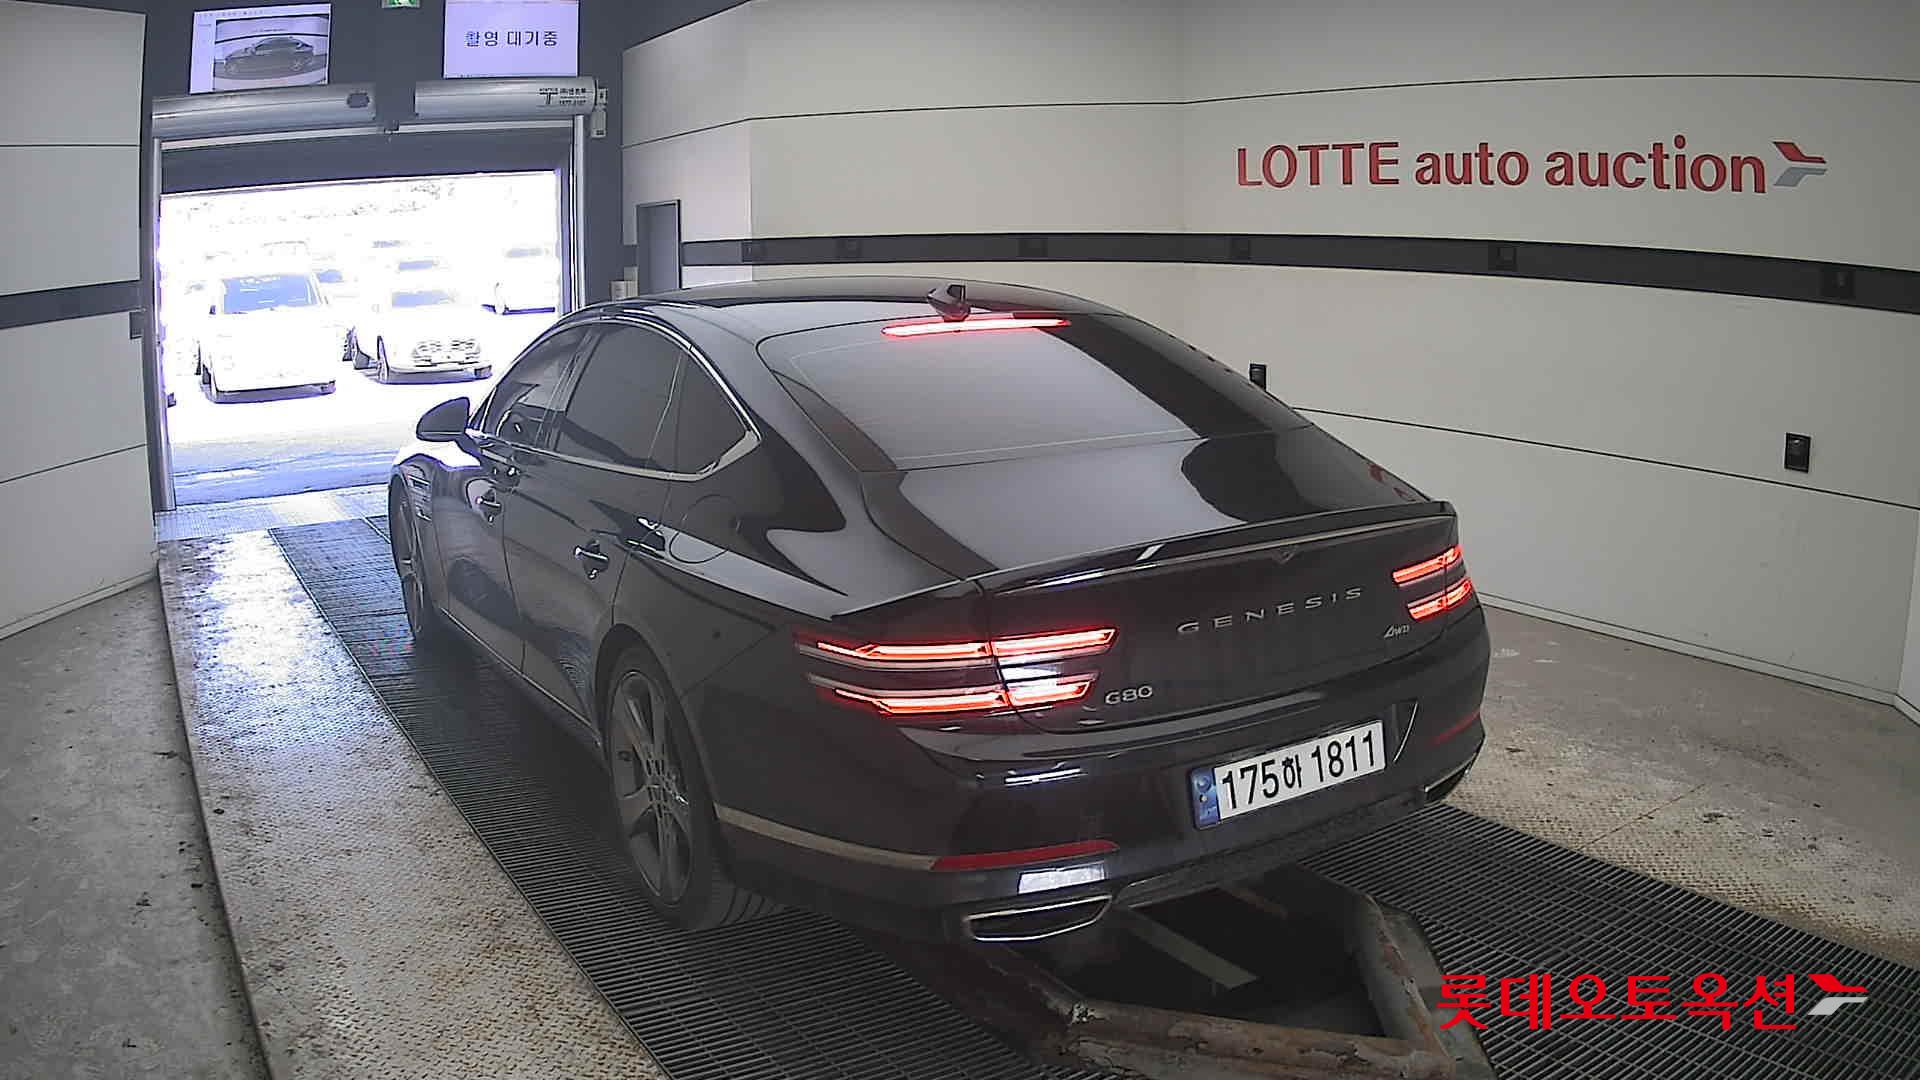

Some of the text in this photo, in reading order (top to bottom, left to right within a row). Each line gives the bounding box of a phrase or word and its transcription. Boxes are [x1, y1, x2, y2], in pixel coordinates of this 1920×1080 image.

[506, 30, 558, 48] 대기중
[1236, 134, 1768, 195] LOTTE auto auction
[1176, 587, 1362, 635] GENESIS
[1104, 685, 1153, 705] G80
[1222, 729, 1375, 810] 175하 1811
